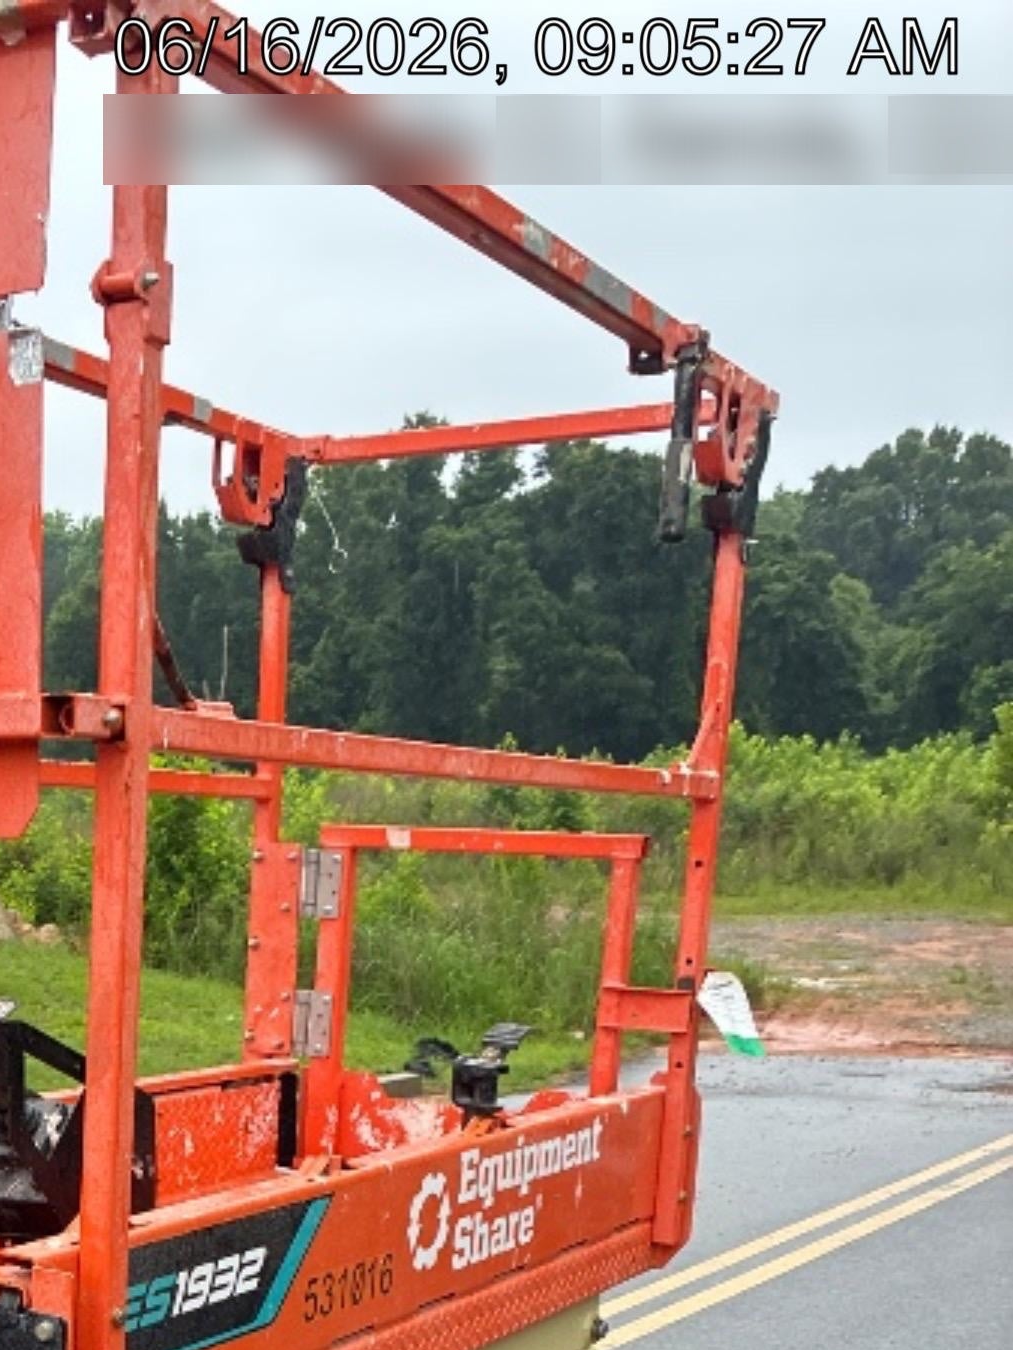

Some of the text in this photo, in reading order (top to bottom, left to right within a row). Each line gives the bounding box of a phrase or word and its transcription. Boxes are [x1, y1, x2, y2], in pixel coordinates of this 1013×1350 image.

[457, 1115, 604, 1209] Equipment
[451, 1205, 536, 1271] Share
[303, 1253, 394, 1323] 531016
